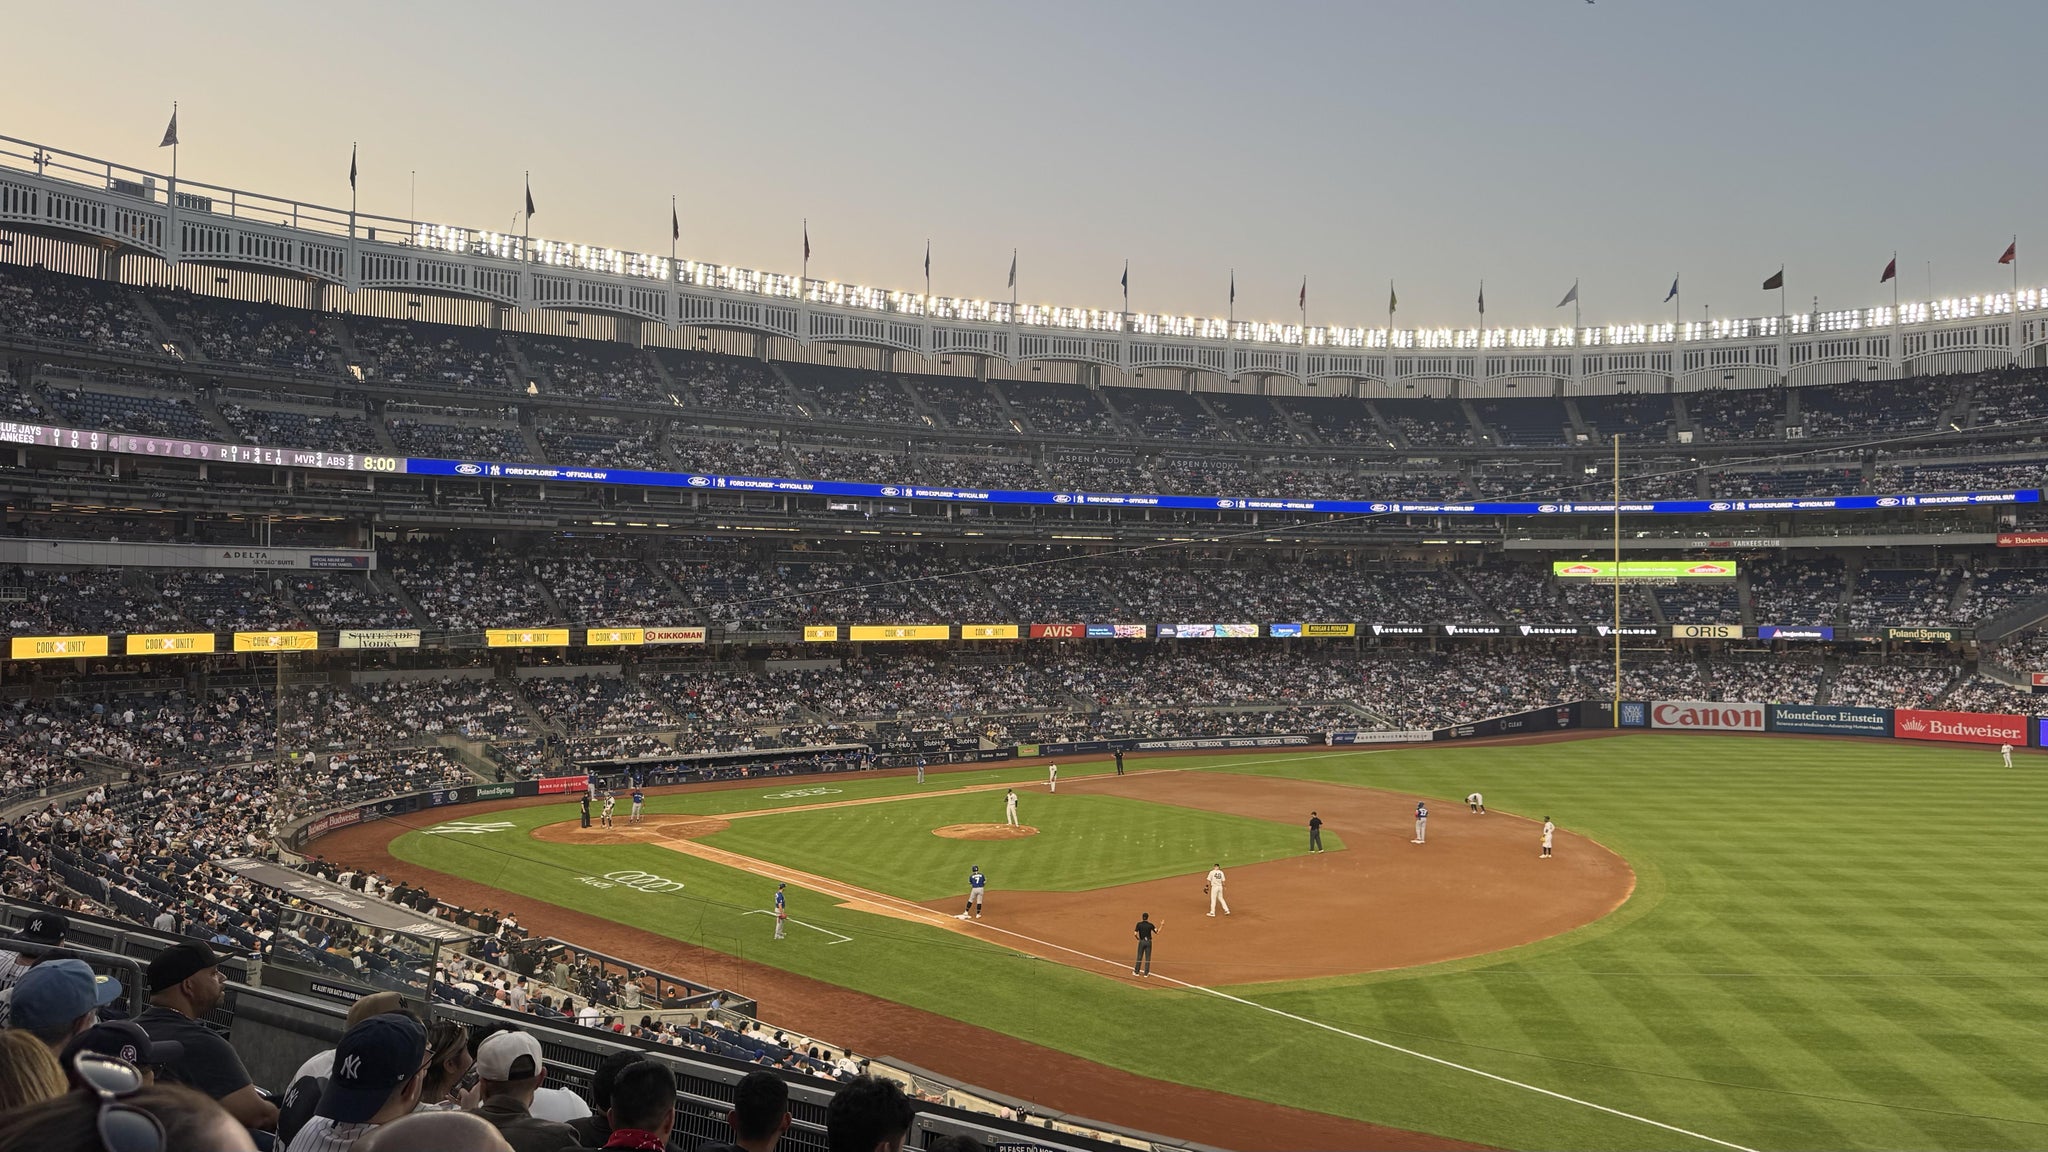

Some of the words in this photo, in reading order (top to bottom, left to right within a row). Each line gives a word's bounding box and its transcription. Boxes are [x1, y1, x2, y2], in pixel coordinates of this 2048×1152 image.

[19, 425, 42, 436] JAYS
[54, 429, 60, 438] 0
[71, 431, 78, 440] 0
[91, 433, 98, 441] 0
[55, 438, 59, 447] 1
[71, 440, 78, 448] 0
[91, 441, 98, 450] 0
[109, 437, 118, 449] 4
[128, 439, 137, 451] 5
[147, 440, 156, 452] 6
[165, 442, 172, 454] 7
[183, 444, 191, 456] 8
[200, 445, 209, 457] 9
[221, 448, 228, 458] R
[231, 446, 237, 455] 0
[243, 450, 250, 460] H
[254, 448, 260, 456] 3
[265, 452, 271, 462] E
[276, 449, 280, 457] 1
[294, 454, 315, 465] MVR
[316, 452, 322, 460] 3
[326, 456, 346, 466] ABS
[347, 454, 354, 462] 2
[363, 457, 396, 472] 8:00
[254, 455, 261, 464] 4
[275, 457, 281, 465] 0
[316, 460, 322, 468] 4
[347, 462, 354, 470] 2
[1059, 455, 1090, 463] ASPEN
[1101, 457, 1132, 465] VODKA
[1170, 460, 1200, 468] ASPEN
[1210, 461, 1240, 469] VODKA
[566, 471, 593, 479] OFFICIAL
[1763, 539, 1780, 547] CLUB
[658, 632, 702, 640] KIKKOMAN
[1043, 625, 1073, 637] AVIS
[1686, 626, 1729, 637] ORIS
[1889, 628, 1919, 638] Poland
[1921, 629, 1951, 641] Spring
[1653, 704, 1762, 727] Canon
[1776, 710, 1837, 721] Montefiore
[1839, 712, 1884, 723] Einstein
[1930, 721, 2021, 738] Budweiser
[496, 787, 515, 795] Spring
[329, 812, 360, 826] Budweiser
[574, 876, 613, 889] Audi
[30, 919, 43, 932] NY
[340, 1054, 361, 1079] NY
[285, 1088, 299, 1109] NY
